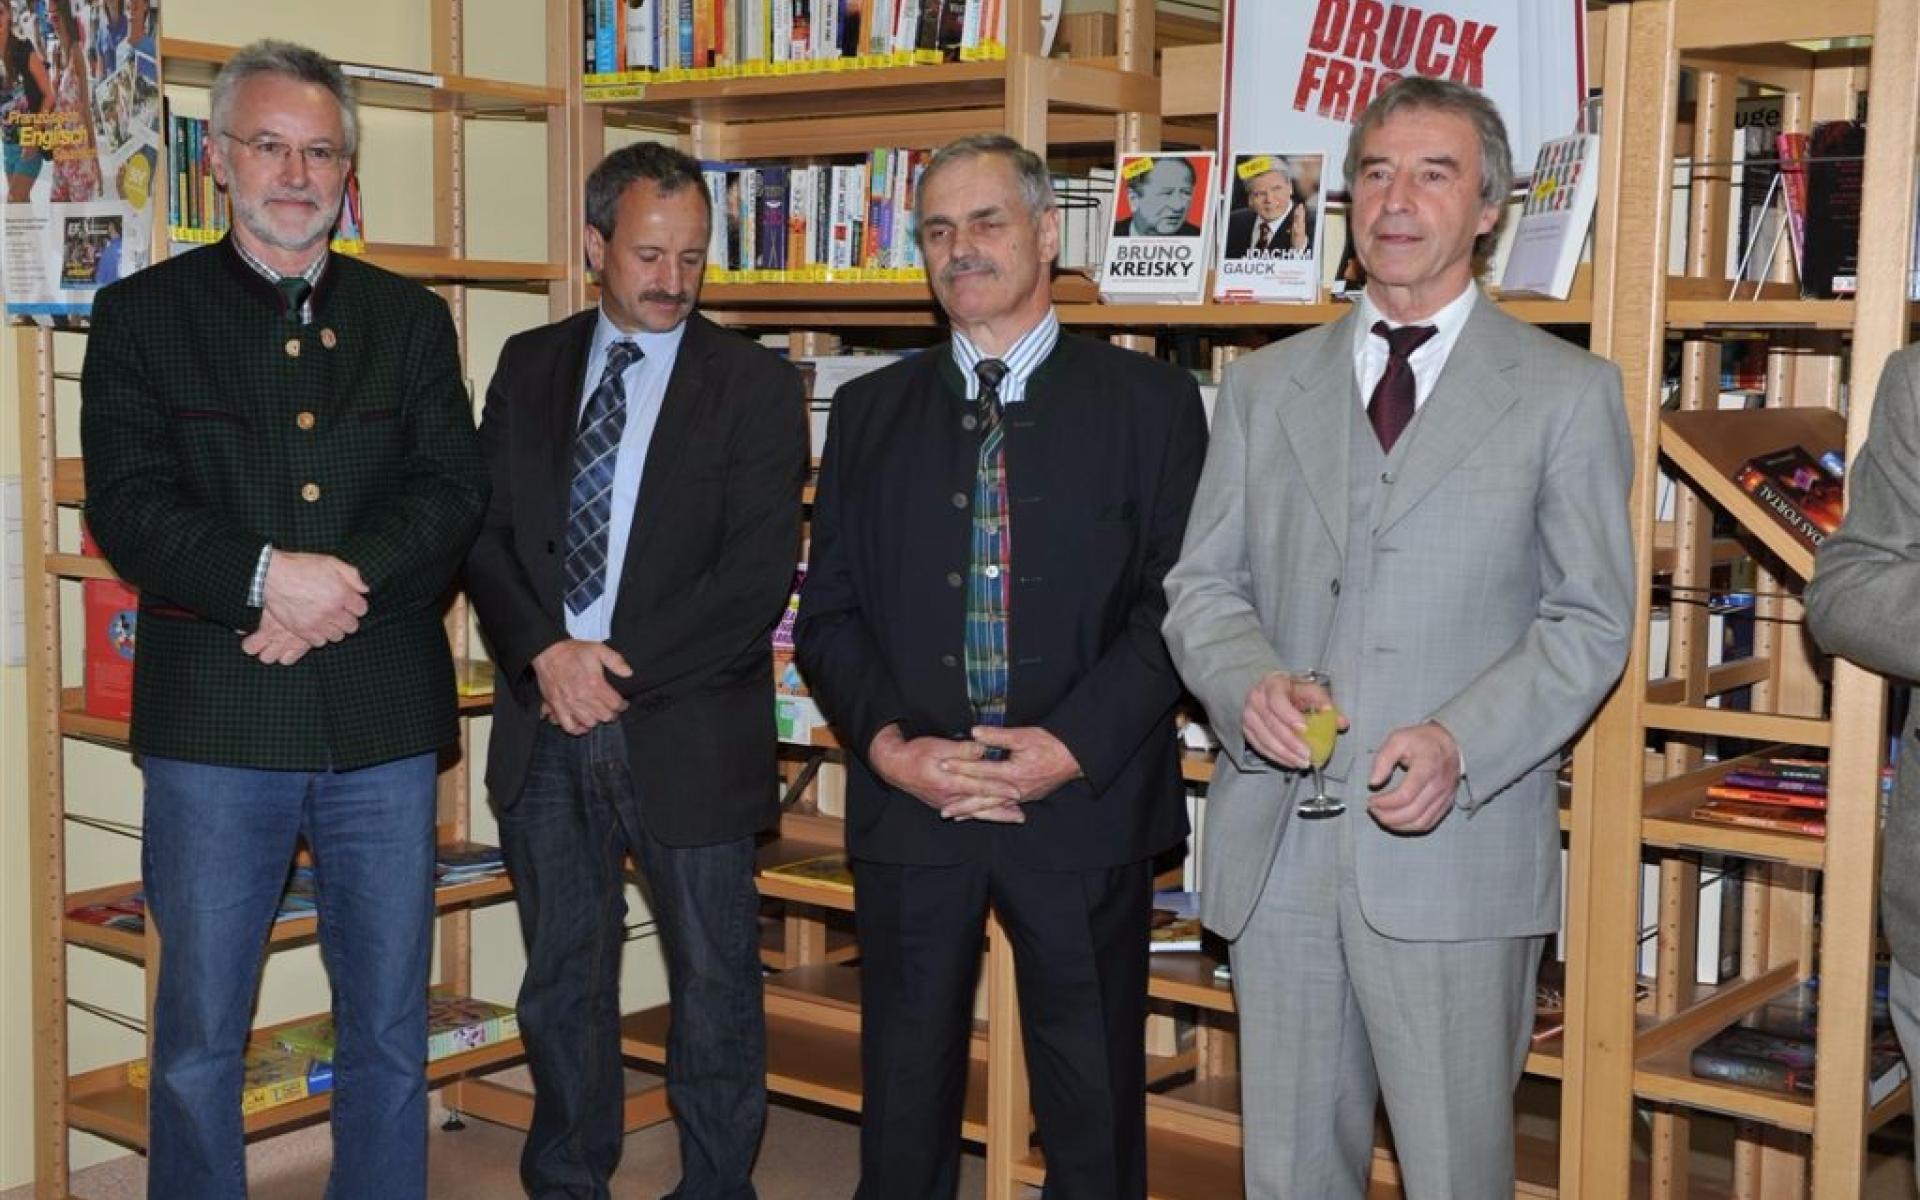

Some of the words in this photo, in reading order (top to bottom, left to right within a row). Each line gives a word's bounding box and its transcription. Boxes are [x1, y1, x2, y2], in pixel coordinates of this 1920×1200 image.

[1308, 0, 1498, 89] DRUCK
[20, 126, 88, 150] Englisch
[1117, 245, 1191, 261] BRUNO
[1240, 248, 1313, 260] JOACHIM
[1109, 261, 1194, 276] KREISKY
[1224, 262, 1275, 274] GAUCK
[1761, 486, 1802, 526] PORTAL
[1800, 522, 1825, 545] DAS
